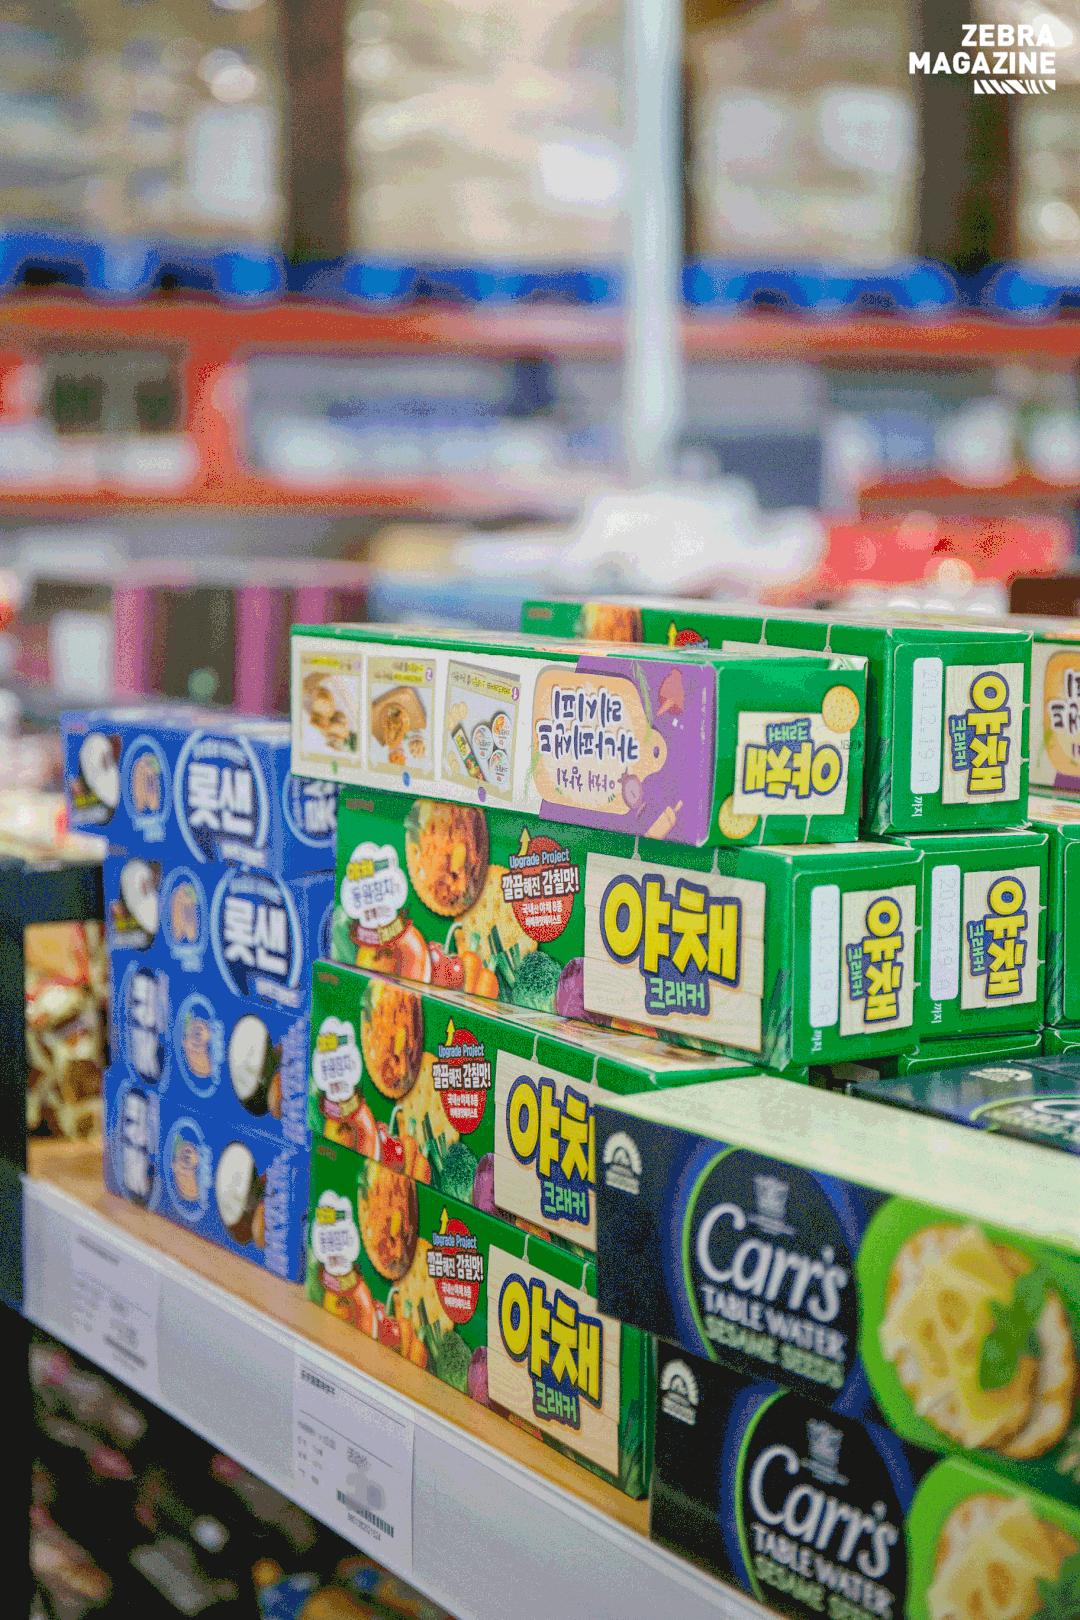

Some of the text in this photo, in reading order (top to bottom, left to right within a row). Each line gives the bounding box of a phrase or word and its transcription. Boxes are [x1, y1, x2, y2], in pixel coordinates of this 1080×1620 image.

[553, 689, 623, 728] 레시피
[768, 720, 809, 743] 크래커
[538, 722, 639, 764] 카나페샌드
[951, 718, 968, 768] 크래커
[967, 674, 1010, 793] 야채
[743, 741, 841, 796] 야채
[911, 795, 923, 818] 까지
[509, 848, 570, 869] Upgrade Project
[541, 867, 580, 897] 감칠맛!
[602, 880, 739, 982] 야채
[968, 923, 985, 973] 크래커
[984, 879, 1026, 996] 야채
[848, 946, 864, 997] 크래커
[862, 899, 902, 1021] 야채
[649, 976, 706, 1011] 크래커
[438, 1043, 485, 1059] Upgrade Project
[462, 1062, 491, 1089] 감칠맛!
[543, 1181, 587, 1221] 크래커
[697, 1201, 849, 1322] Carr's
[500, 1280, 601, 1400] 야채
[535, 1381, 578, 1423] 크래커
[749, 1442, 899, 1580] Carr's
